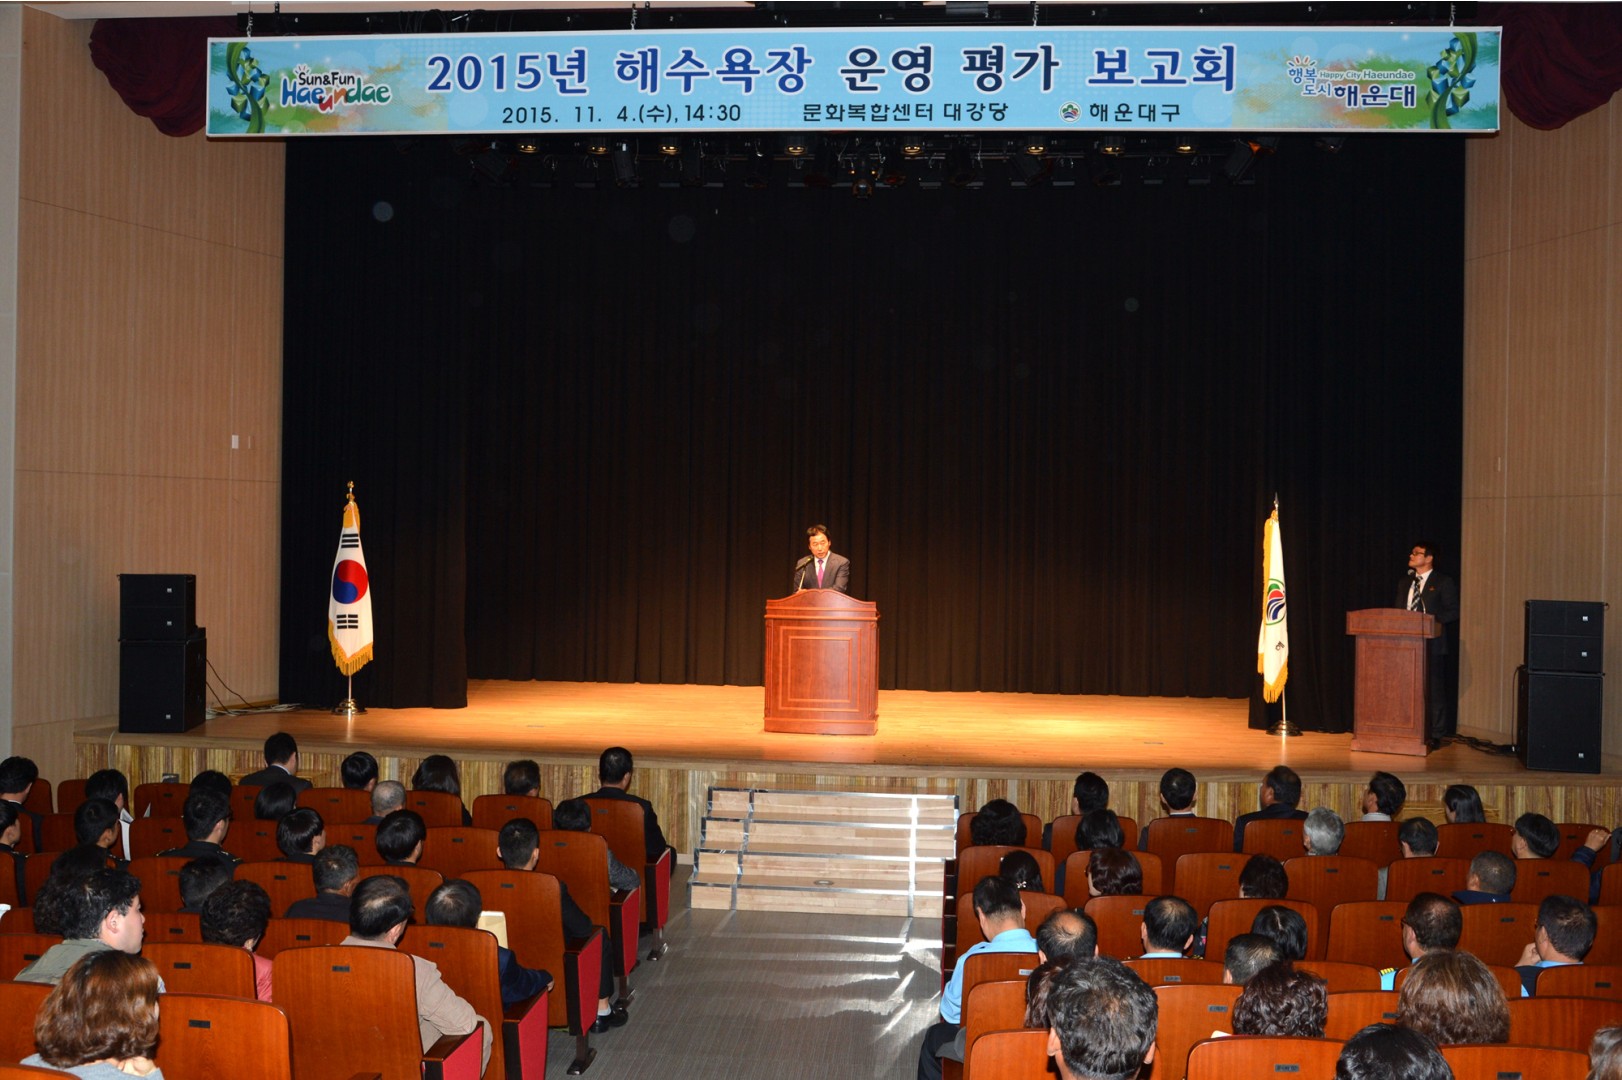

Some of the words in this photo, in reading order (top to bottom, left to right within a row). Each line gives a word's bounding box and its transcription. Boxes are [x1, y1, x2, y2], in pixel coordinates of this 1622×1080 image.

[298, 71, 355, 86] Sun&Fun
[428, 49, 587, 94] 2015년
[615, 46, 812, 93] 해수욕장
[840, 45, 932, 92] 운영
[962, 45, 1060, 92] 평가
[1088, 45, 1234, 92] 보고회
[1288, 68, 1317, 83] 행복
[1320, 71, 1344, 80] Happy
[1346, 71, 1361, 80] City
[1363, 70, 1414, 80] Haeundae
[282, 77, 391, 111] Haeundae
[1303, 83, 1331, 96] 도시
[1334, 85, 1416, 107] 해운대
[502, 106, 559, 123] 2015.
[574, 106, 602, 122] 11.
[803, 103, 933, 122] 문화복합센터
[943, 102, 1009, 122] 대강당
[1089, 102, 1181, 122] 해운대구
